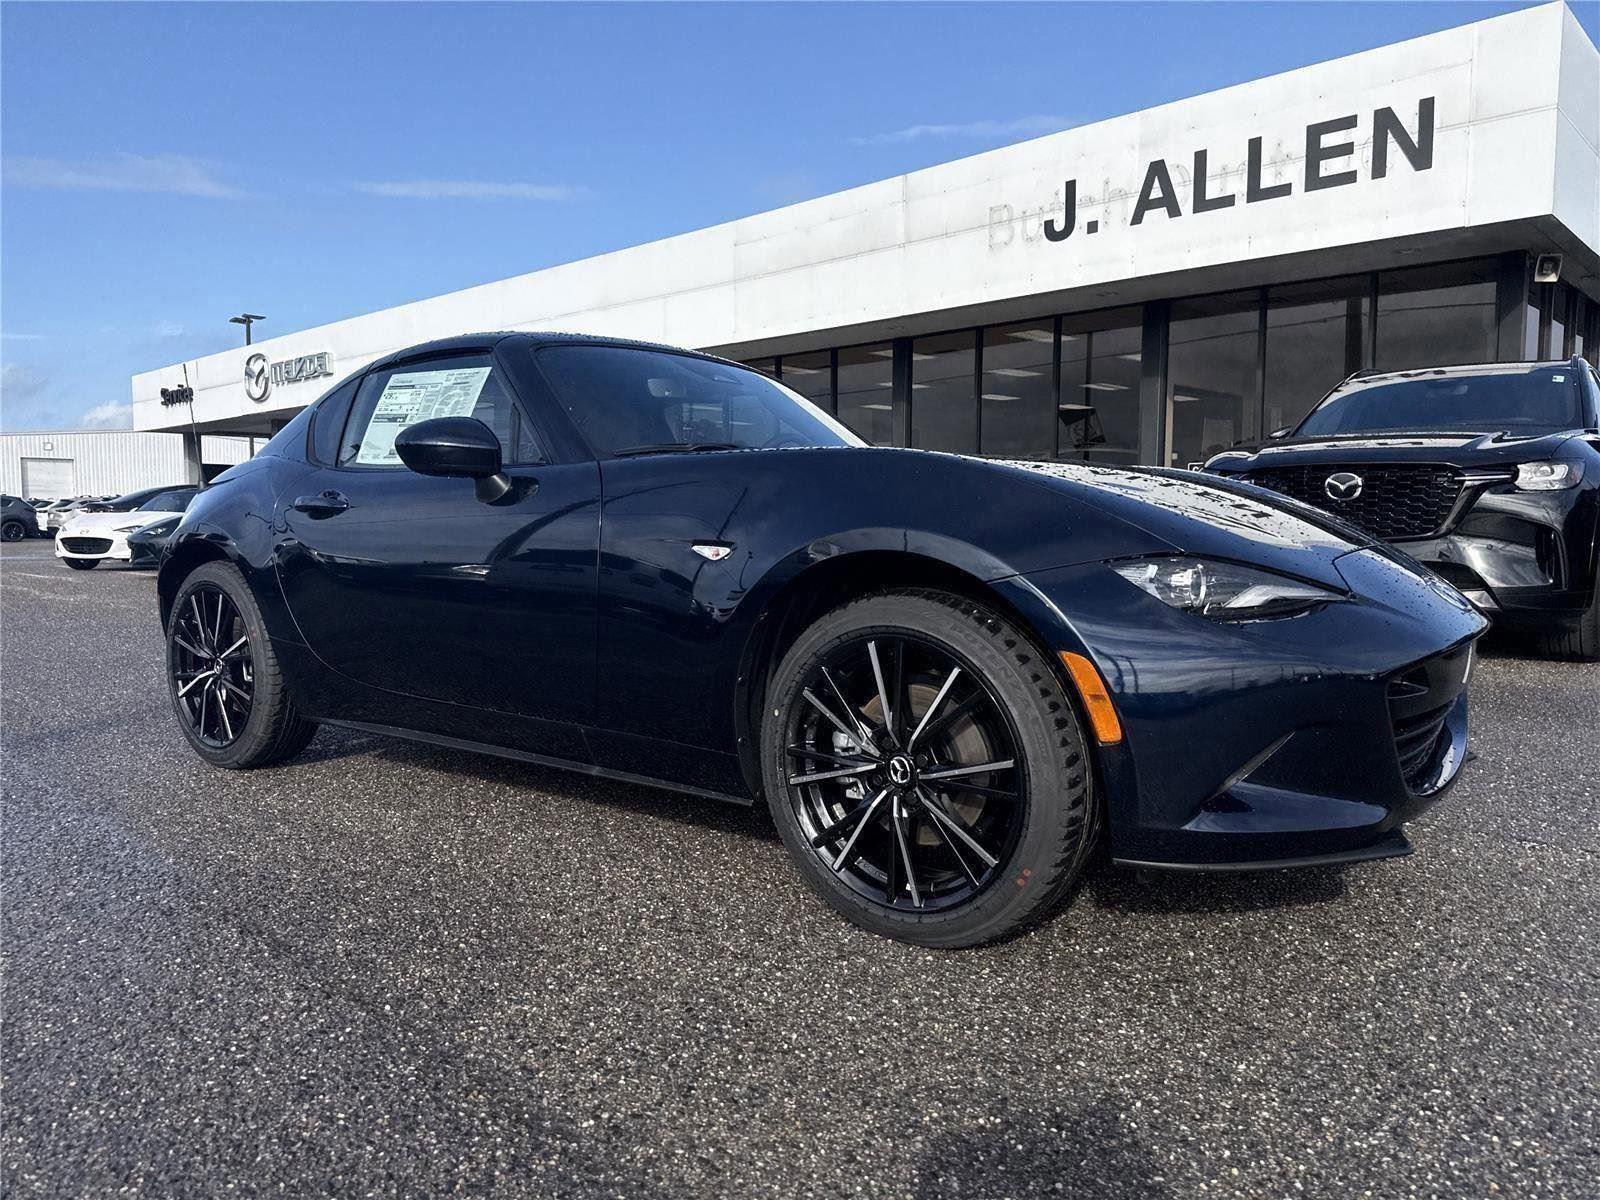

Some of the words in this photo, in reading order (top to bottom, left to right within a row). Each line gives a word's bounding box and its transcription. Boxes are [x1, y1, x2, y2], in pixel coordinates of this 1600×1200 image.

[1044, 179, 1098, 242] J.
[1129, 96, 1435, 227] ALLEN
[160, 384, 194, 408] Service
